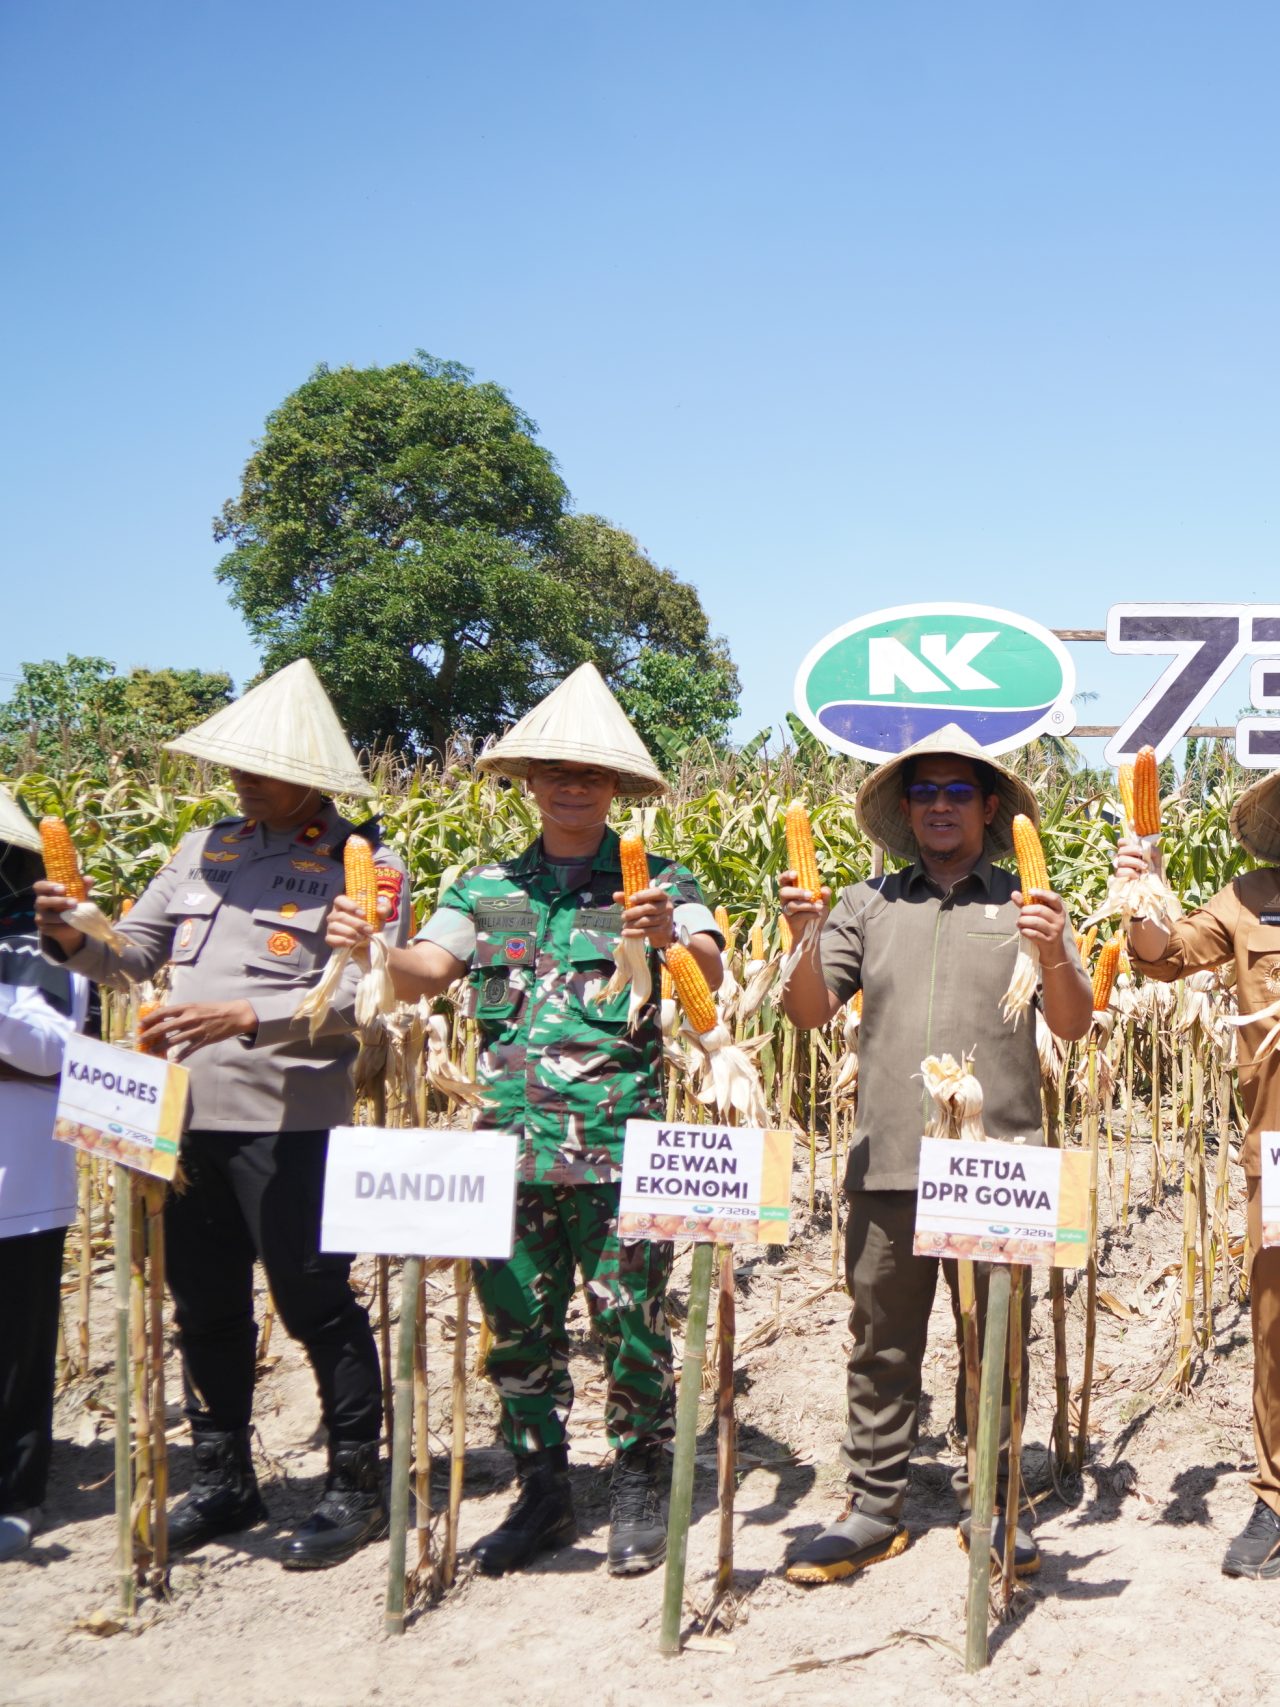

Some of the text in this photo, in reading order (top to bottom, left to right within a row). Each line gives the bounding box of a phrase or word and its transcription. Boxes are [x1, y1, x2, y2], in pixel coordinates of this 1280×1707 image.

[868, 631, 1001, 696] NK
[271, 874, 329, 897] POLRI
[68, 1060, 159, 1104] KAPOLRES
[656, 1129, 733, 1151] KETUA
[649, 1153, 738, 1174] DEWAN
[949, 1156, 1027, 1181] KETUA
[354, 1171, 486, 1203] DANDIM
[635, 1176, 749, 1199] EKONOMI
[921, 1181, 1052, 1210] DPR GOWA
